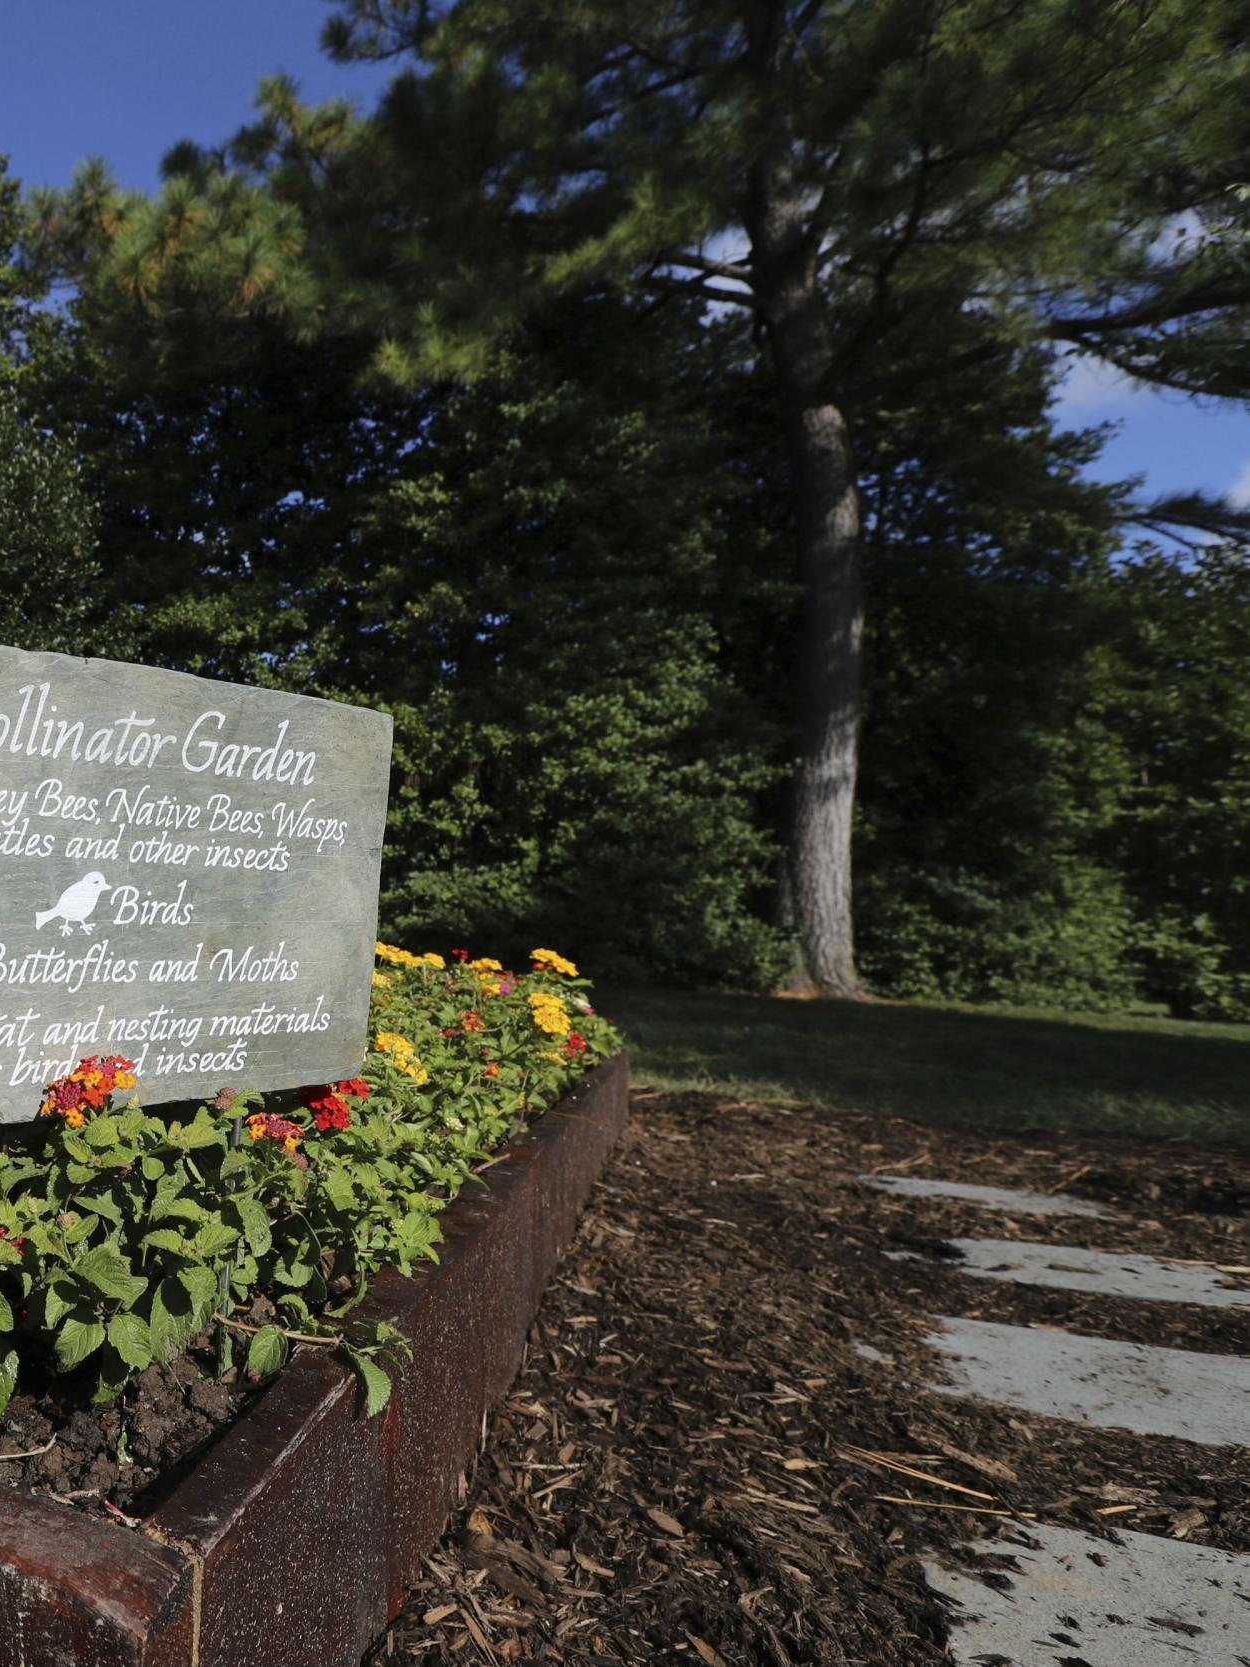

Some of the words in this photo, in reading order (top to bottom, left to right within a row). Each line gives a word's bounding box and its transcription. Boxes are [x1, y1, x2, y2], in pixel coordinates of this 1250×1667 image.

[181, 710, 317, 786] Garden
[35, 779, 101, 826] Bees,
[105, 785, 201, 829] Native
[207, 793, 264, 839] Bees,
[271, 798, 348, 853] Wasps,
[65, 823, 125, 862] and
[129, 830, 200, 866] other
[204, 839, 291, 872] insects
[110, 879, 194, 926] Birds
[149, 942, 204, 983] and
[209, 940, 299, 983] Moths
[42, 1004, 105, 1044] and
[107, 1004, 203, 1047] nesting
[208, 994, 331, 1036] materials
[8, 1044, 82, 1087] bird
[156, 1038, 248, 1076] insects
